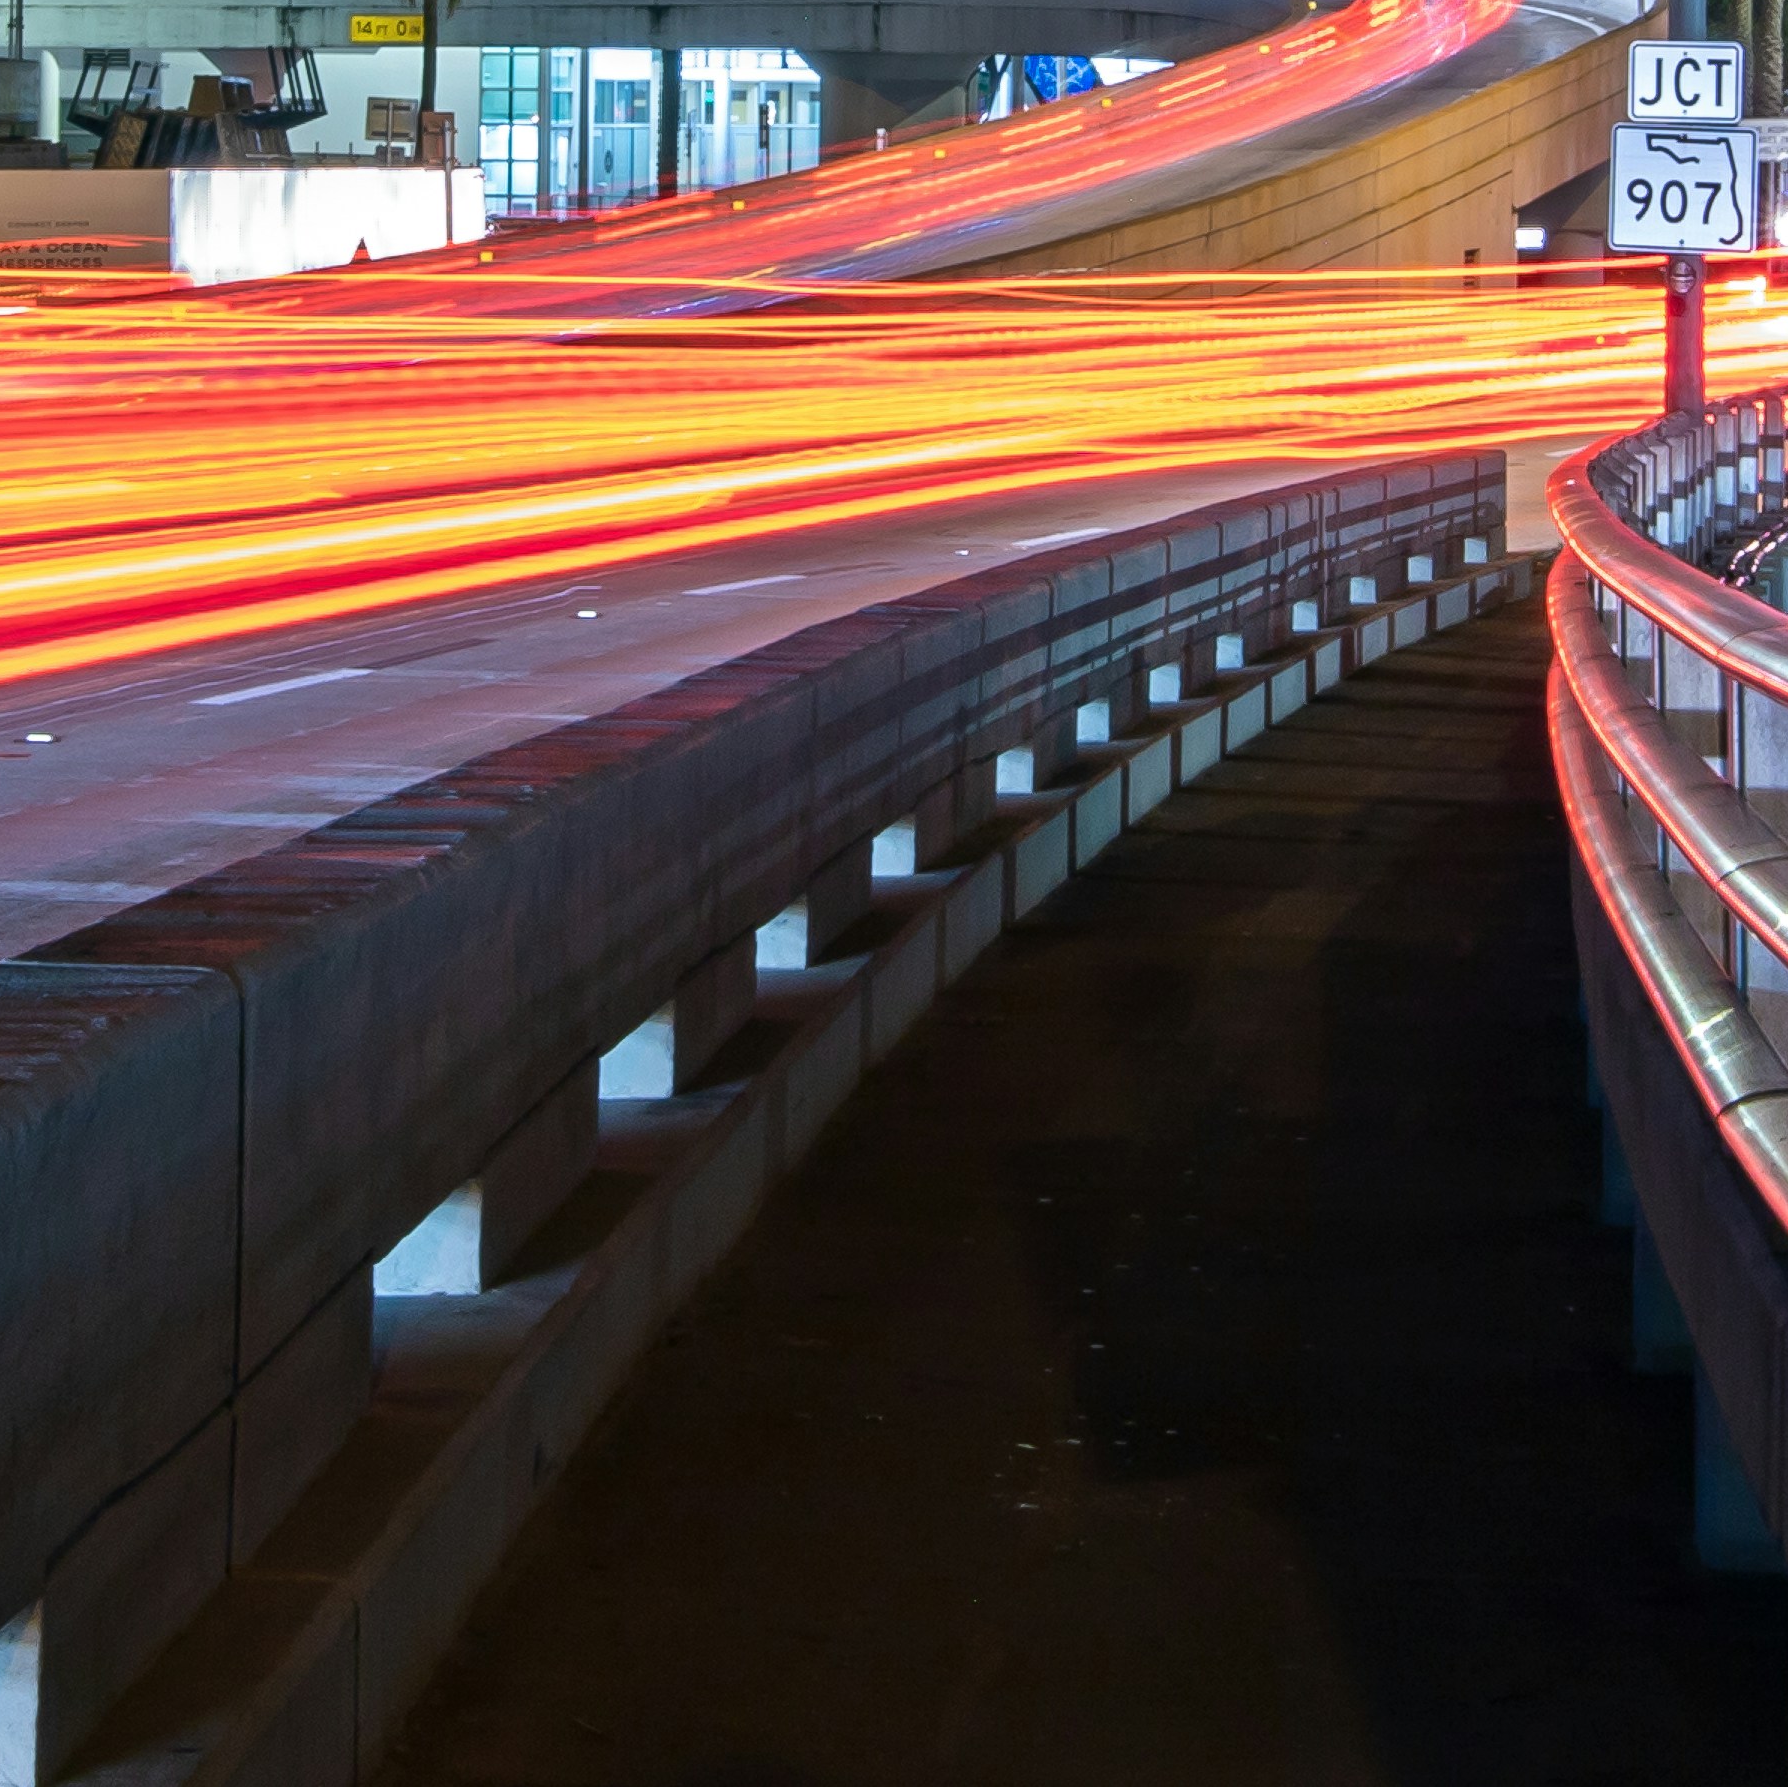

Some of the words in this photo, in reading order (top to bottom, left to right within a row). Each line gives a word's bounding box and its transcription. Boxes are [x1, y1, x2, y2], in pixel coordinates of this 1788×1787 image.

[1639, 58, 1732, 107] JCT
[1626, 178, 1722, 225] 907
[47, 243, 108, 254] OCEAN
